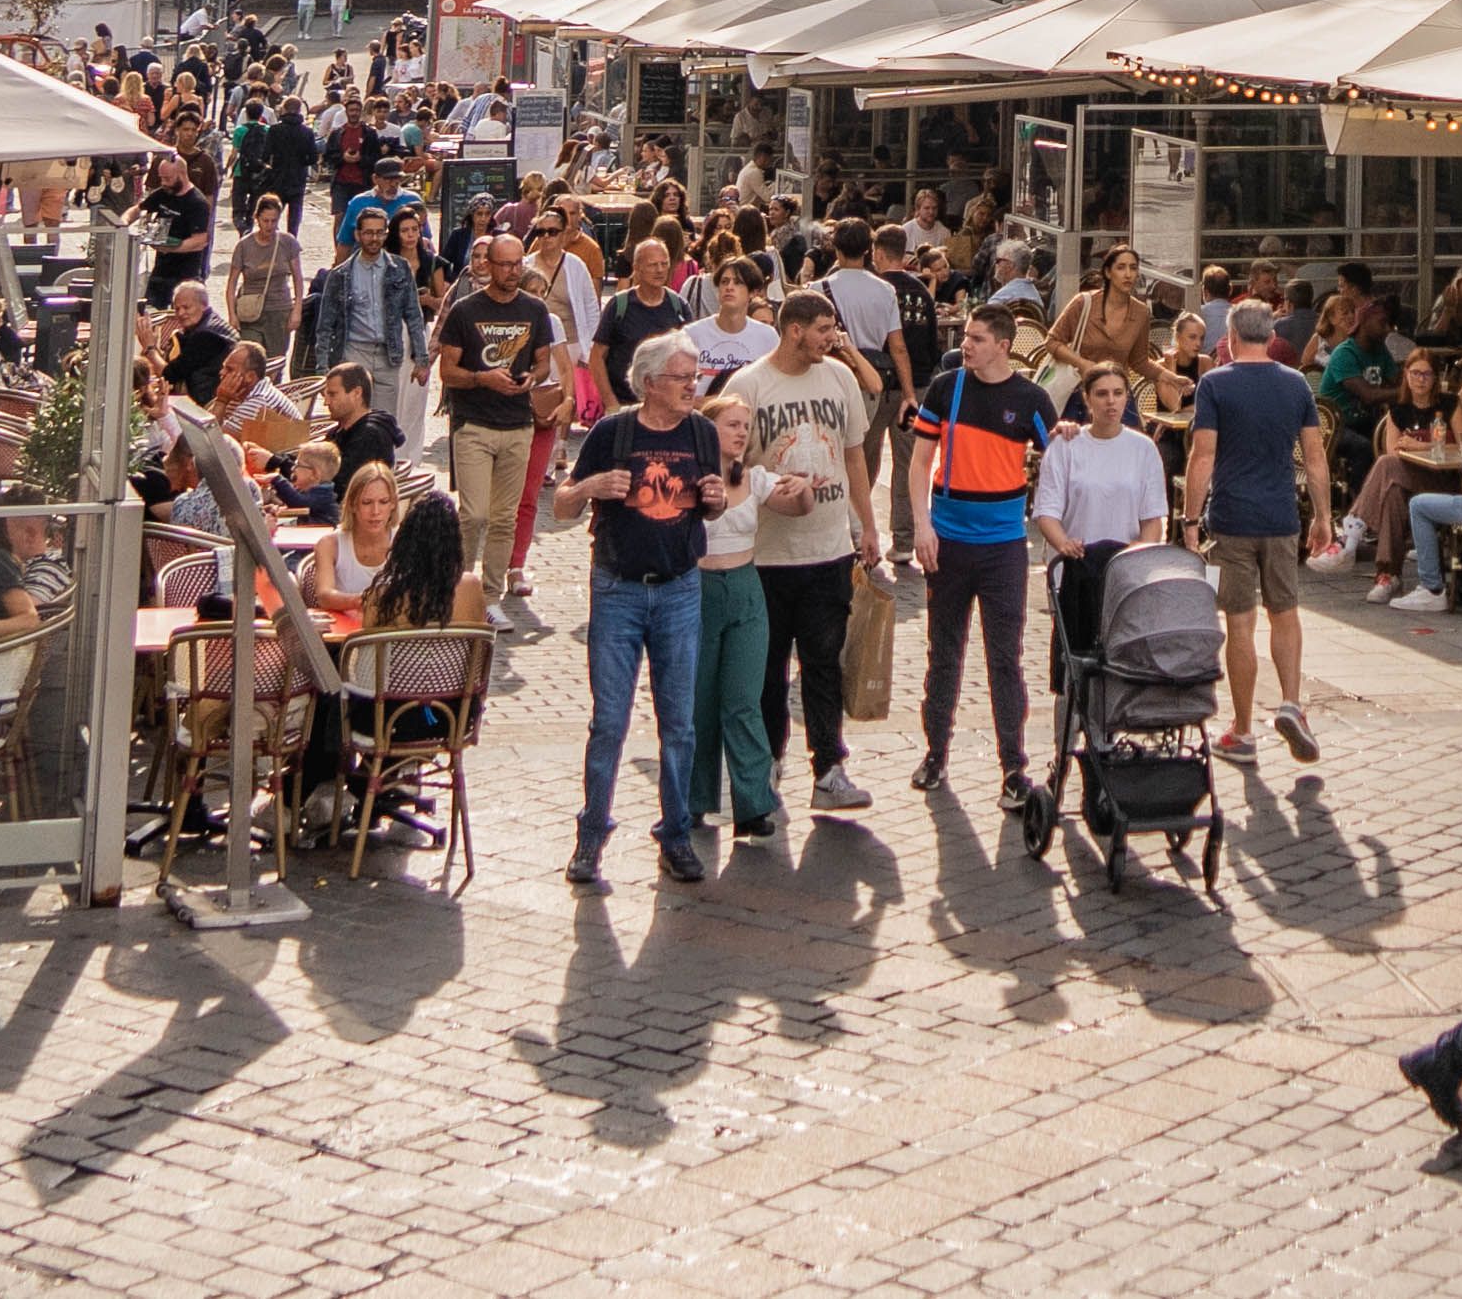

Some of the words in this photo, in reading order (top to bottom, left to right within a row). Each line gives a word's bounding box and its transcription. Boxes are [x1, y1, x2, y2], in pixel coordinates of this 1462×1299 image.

[481, 324, 527, 339] Wrangler
[757, 401, 810, 452] DEATH
[809, 398, 846, 435] ROW
